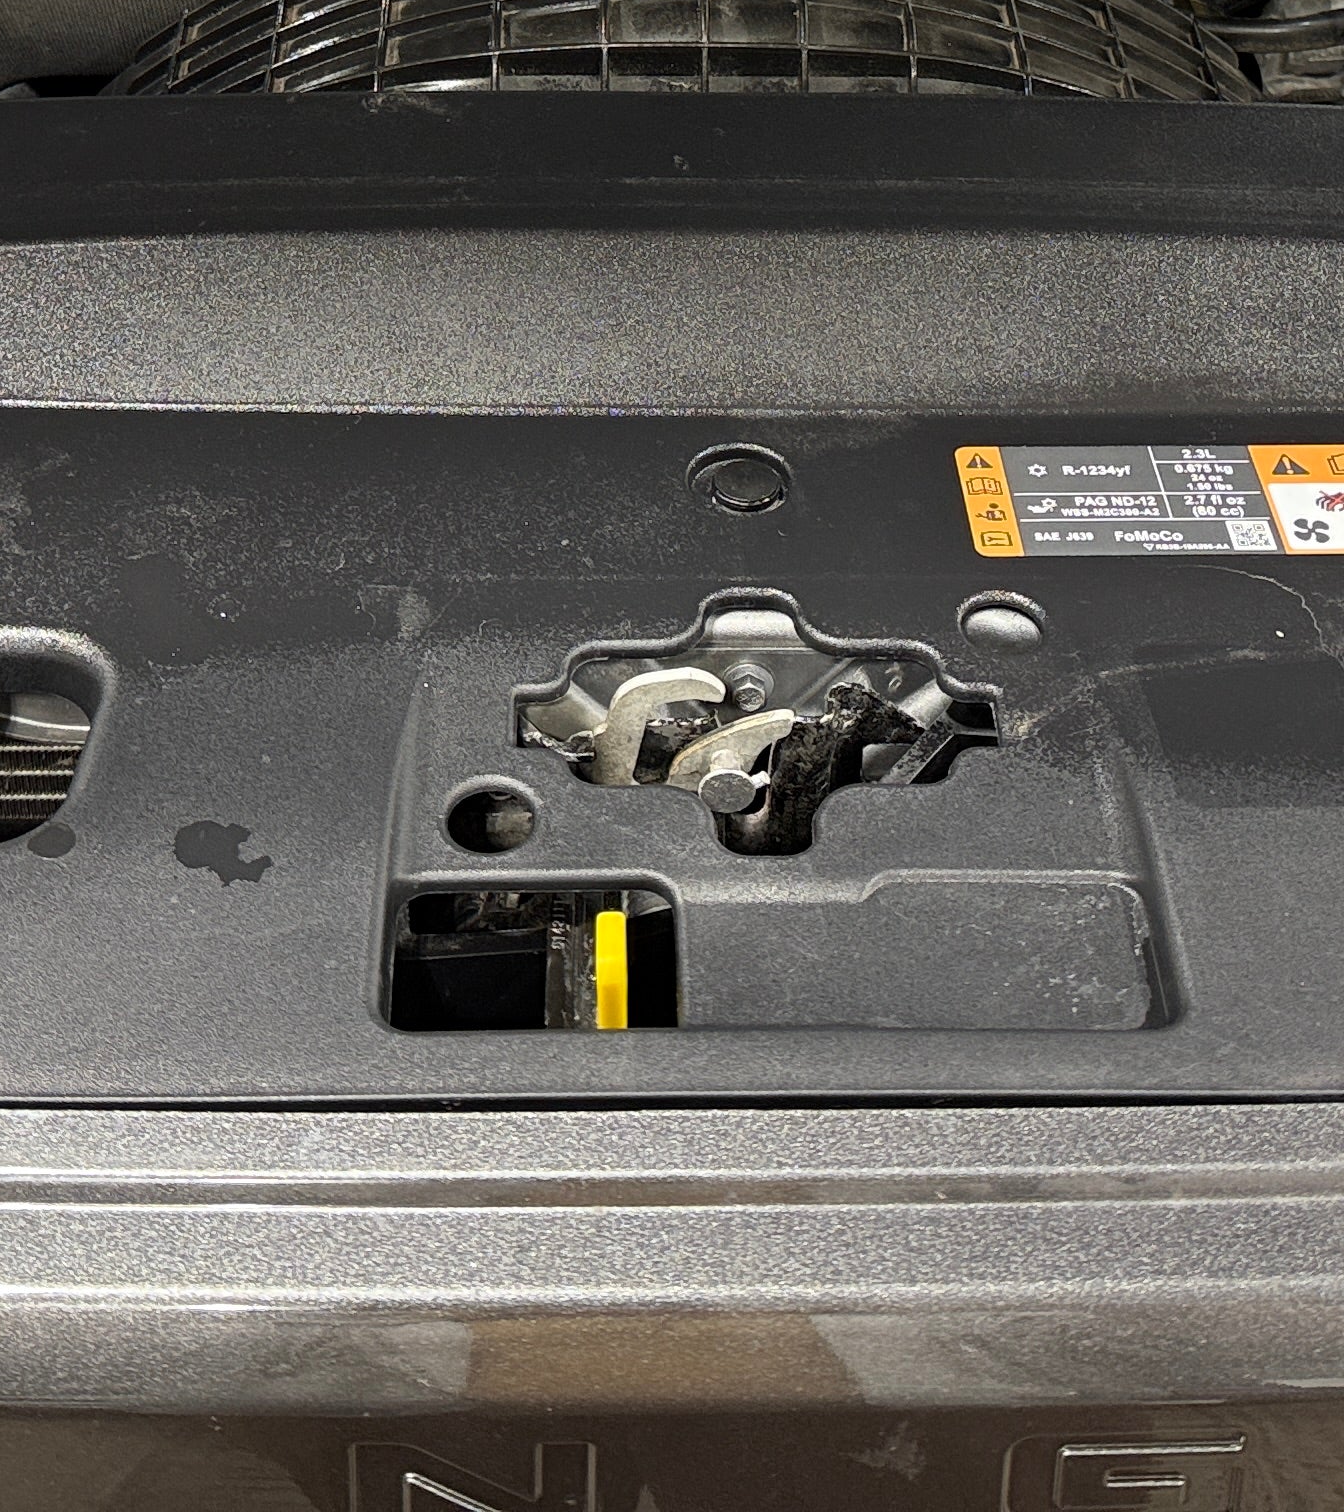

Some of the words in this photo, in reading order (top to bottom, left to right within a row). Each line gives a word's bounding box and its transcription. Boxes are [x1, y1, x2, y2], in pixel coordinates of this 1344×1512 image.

[1181, 449, 1216, 459] 2.3L
[1061, 465, 1131, 477] R-1234yf
[1214, 464, 1234, 475] kg
[1074, 496, 1108, 507] PAG
[1110, 496, 1157, 507] ND-12
[1184, 495, 1206, 505] 2.7
[1210, 495, 1222, 505] fl
[1226, 497, 1246, 505] oz
[1220, 506, 1245, 518] cc)
[1034, 532, 1061, 541] SAE
[1114, 530, 1184, 542] FoMoCo
